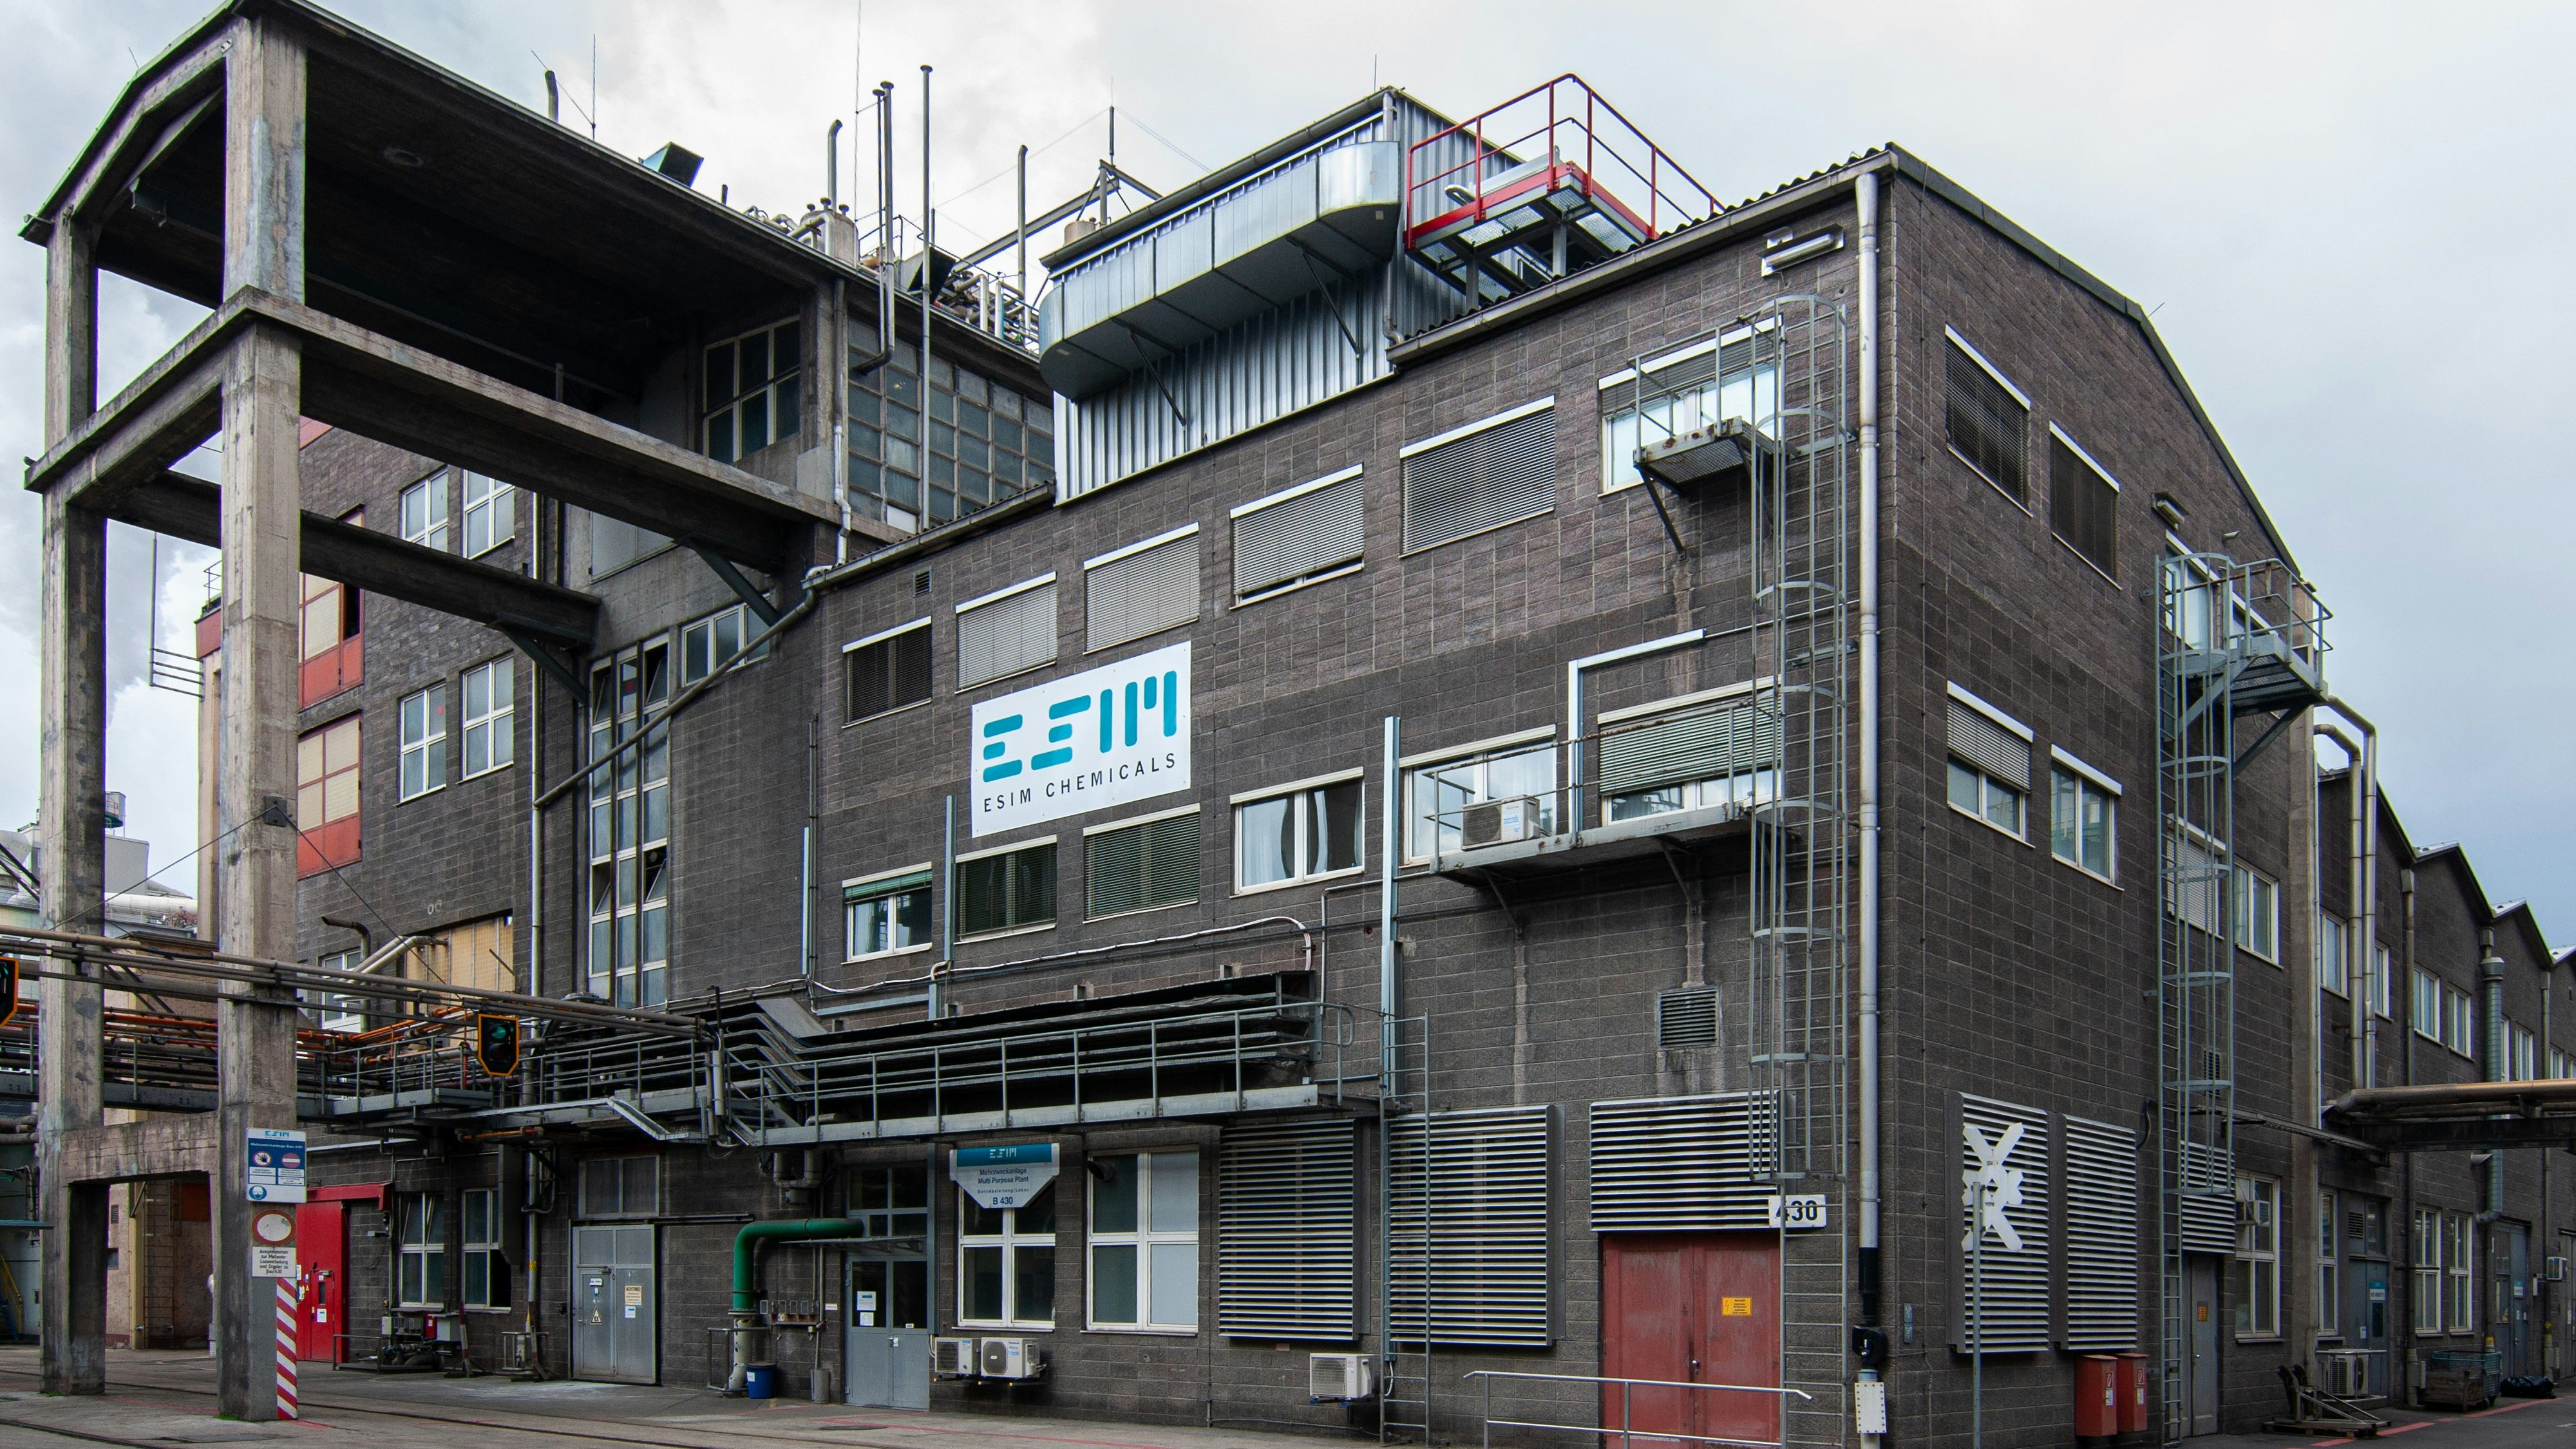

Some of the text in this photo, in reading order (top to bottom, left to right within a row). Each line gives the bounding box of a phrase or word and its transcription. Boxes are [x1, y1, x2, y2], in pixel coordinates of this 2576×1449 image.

[983, 670, 1177, 782] ESIM
[983, 753, 1175, 813] ESIM CHEMICALS
[989, 1148, 1017, 1158] ESIM
[992, 1197, 1013, 1205] B 430
